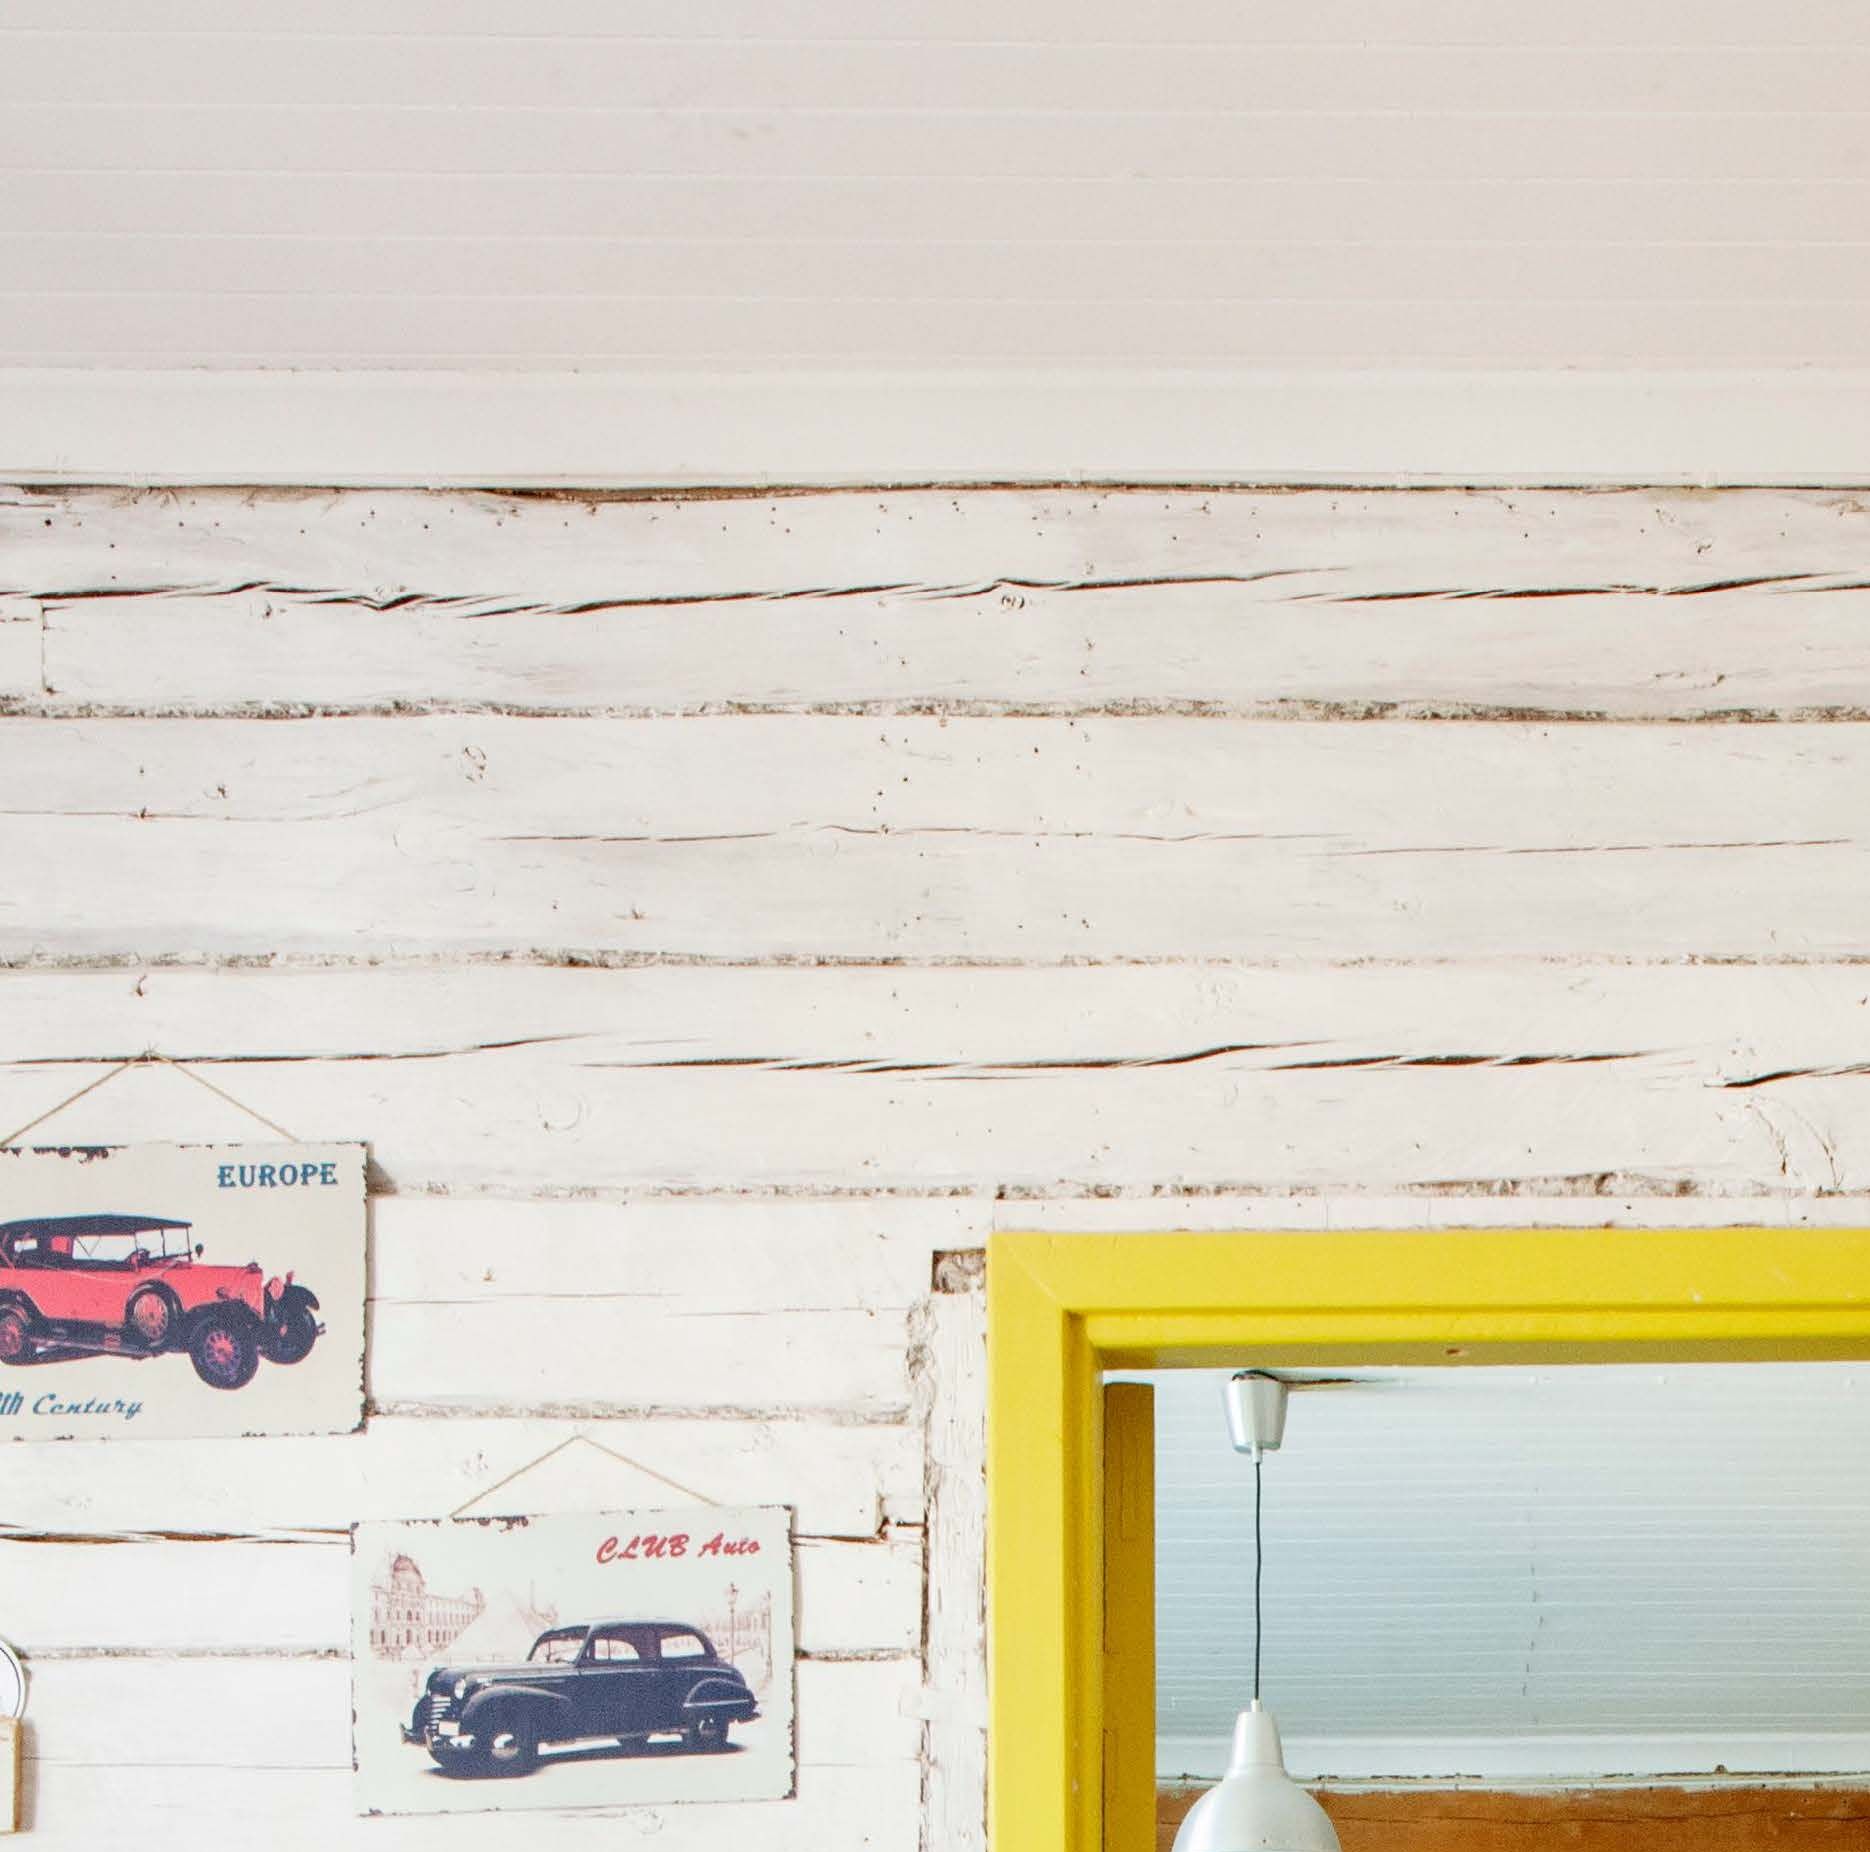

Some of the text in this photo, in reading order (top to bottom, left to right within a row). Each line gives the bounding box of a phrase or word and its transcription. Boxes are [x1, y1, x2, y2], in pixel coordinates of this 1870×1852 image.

[217, 1163, 338, 1188] EUROPE
[32, 1393, 145, 1420] Century
[596, 1531, 761, 1564] CLUB Auto
